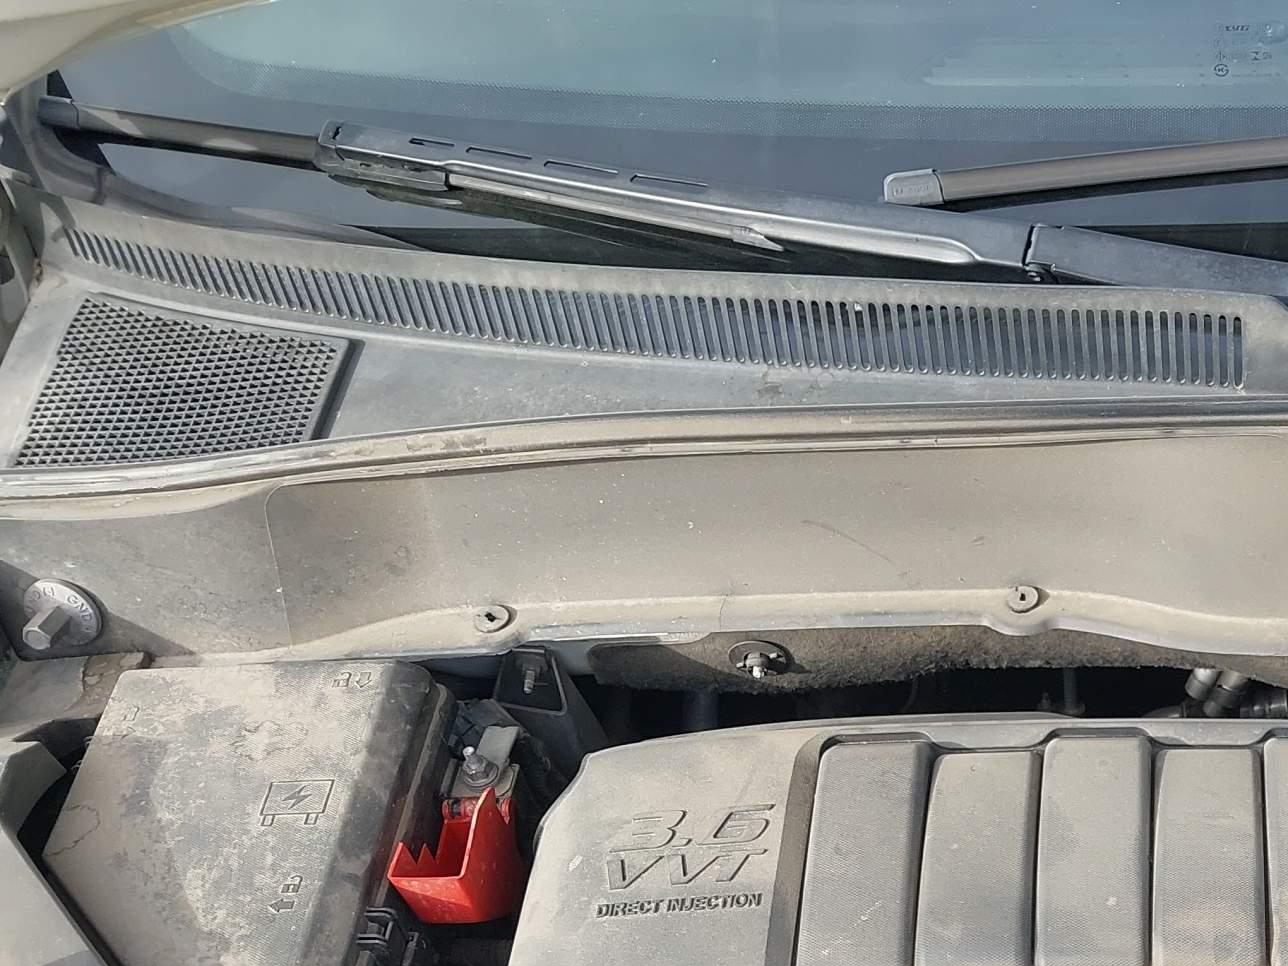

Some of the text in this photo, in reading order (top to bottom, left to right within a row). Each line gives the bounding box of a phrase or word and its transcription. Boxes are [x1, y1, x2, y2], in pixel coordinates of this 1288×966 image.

[609, 803, 777, 854] 3.6
[606, 848, 768, 892] VVT
[596, 892, 763, 919] DIRECT INJECTION
